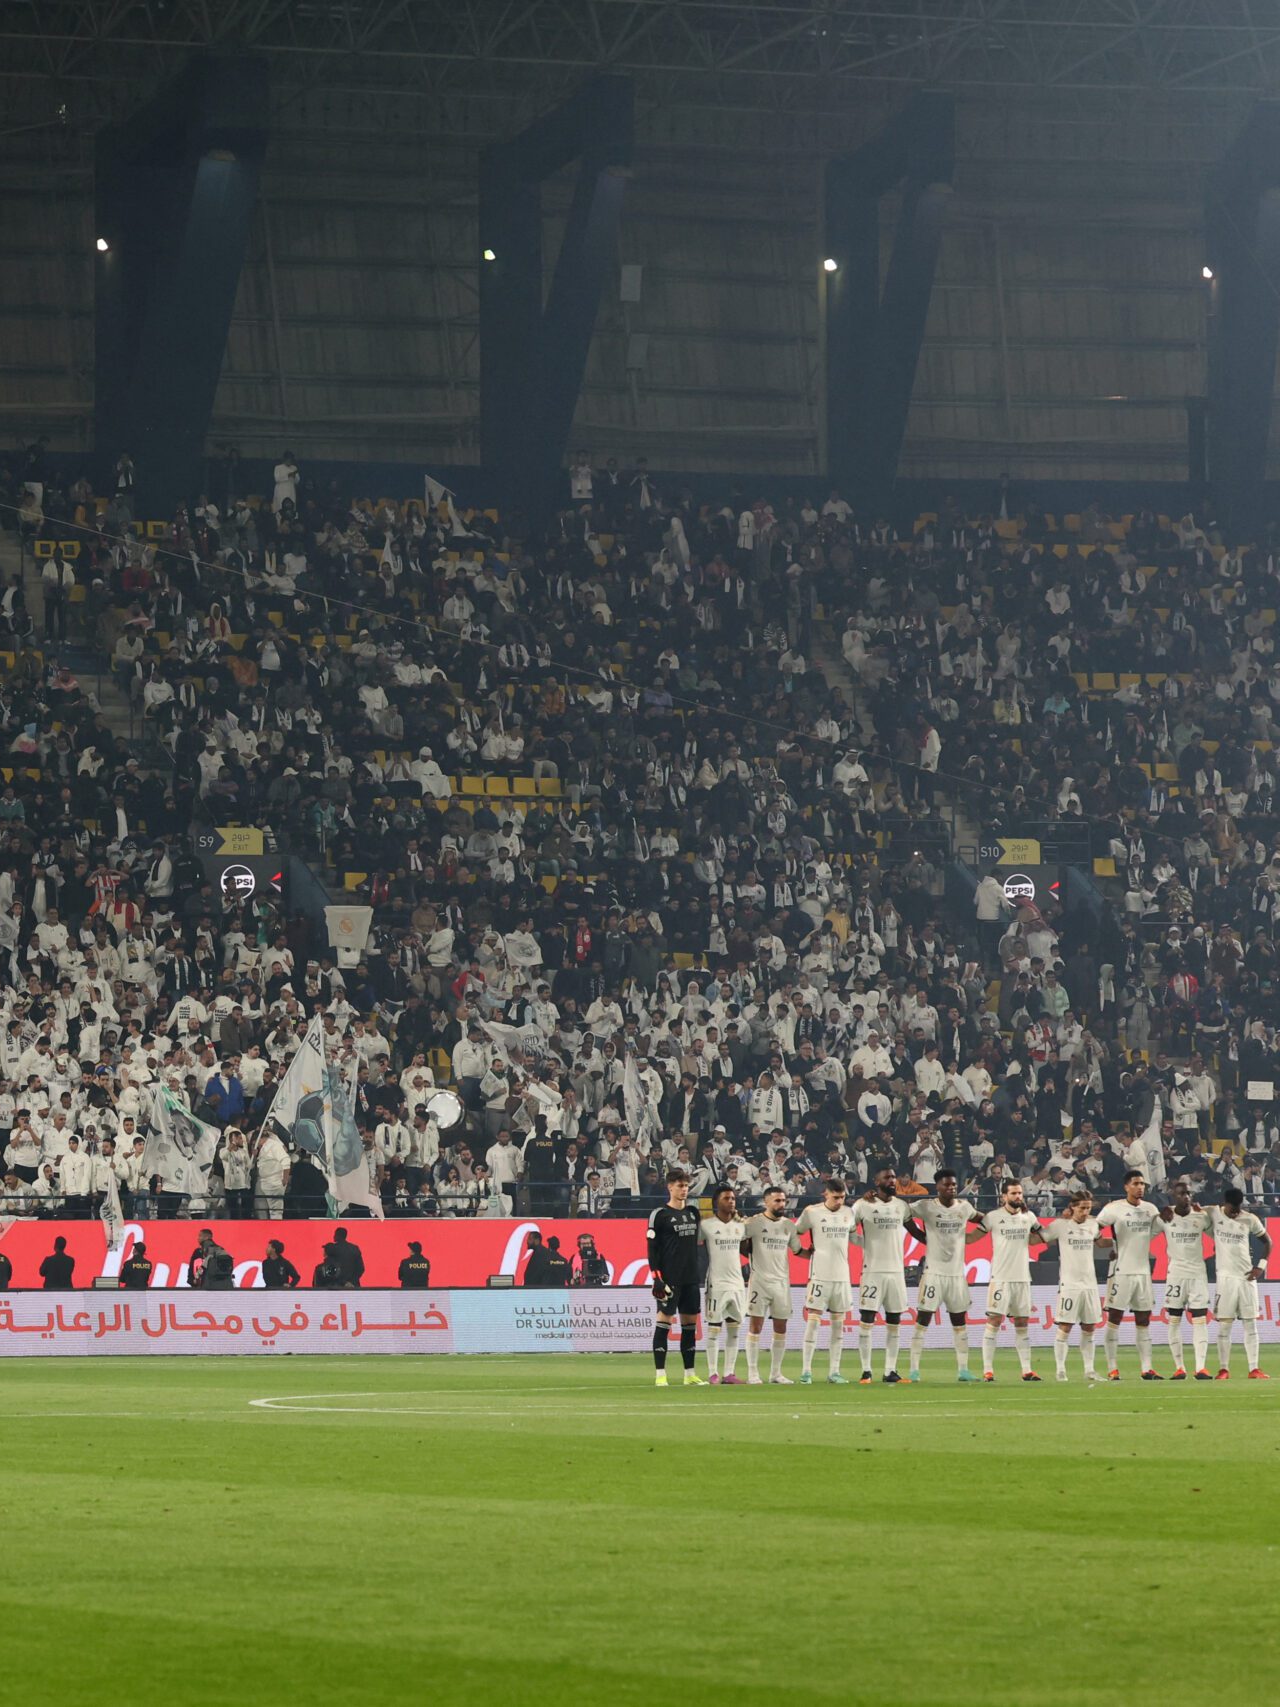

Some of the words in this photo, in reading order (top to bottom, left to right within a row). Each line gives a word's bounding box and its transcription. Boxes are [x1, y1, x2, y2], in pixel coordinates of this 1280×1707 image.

[199, 836, 214, 848] S9
[980, 847, 1000, 858] S10
[810, 1284, 822, 1298] 15
[862, 1285, 878, 1299] 22
[924, 1285, 936, 1298] 18
[994, 1289, 1002, 1300] 6
[1111, 1284, 1118, 1296] 5
[1166, 1284, 1180, 1298] 23
[750, 1290, 758, 1304] 2
[708, 1299, 716, 1312] 11
[1061, 1298, 1072, 1310] 10
[142, 1304, 242, 1337] مجال
[253, 1304, 309, 1344] في
[320, 1302, 449, 1336] خبراء
[516, 1320, 533, 1328] DR
[536, 1318, 597, 1328] SULAIMAN
[600, 1318, 614, 1328] AL
[620, 1318, 652, 1328] HABIB
